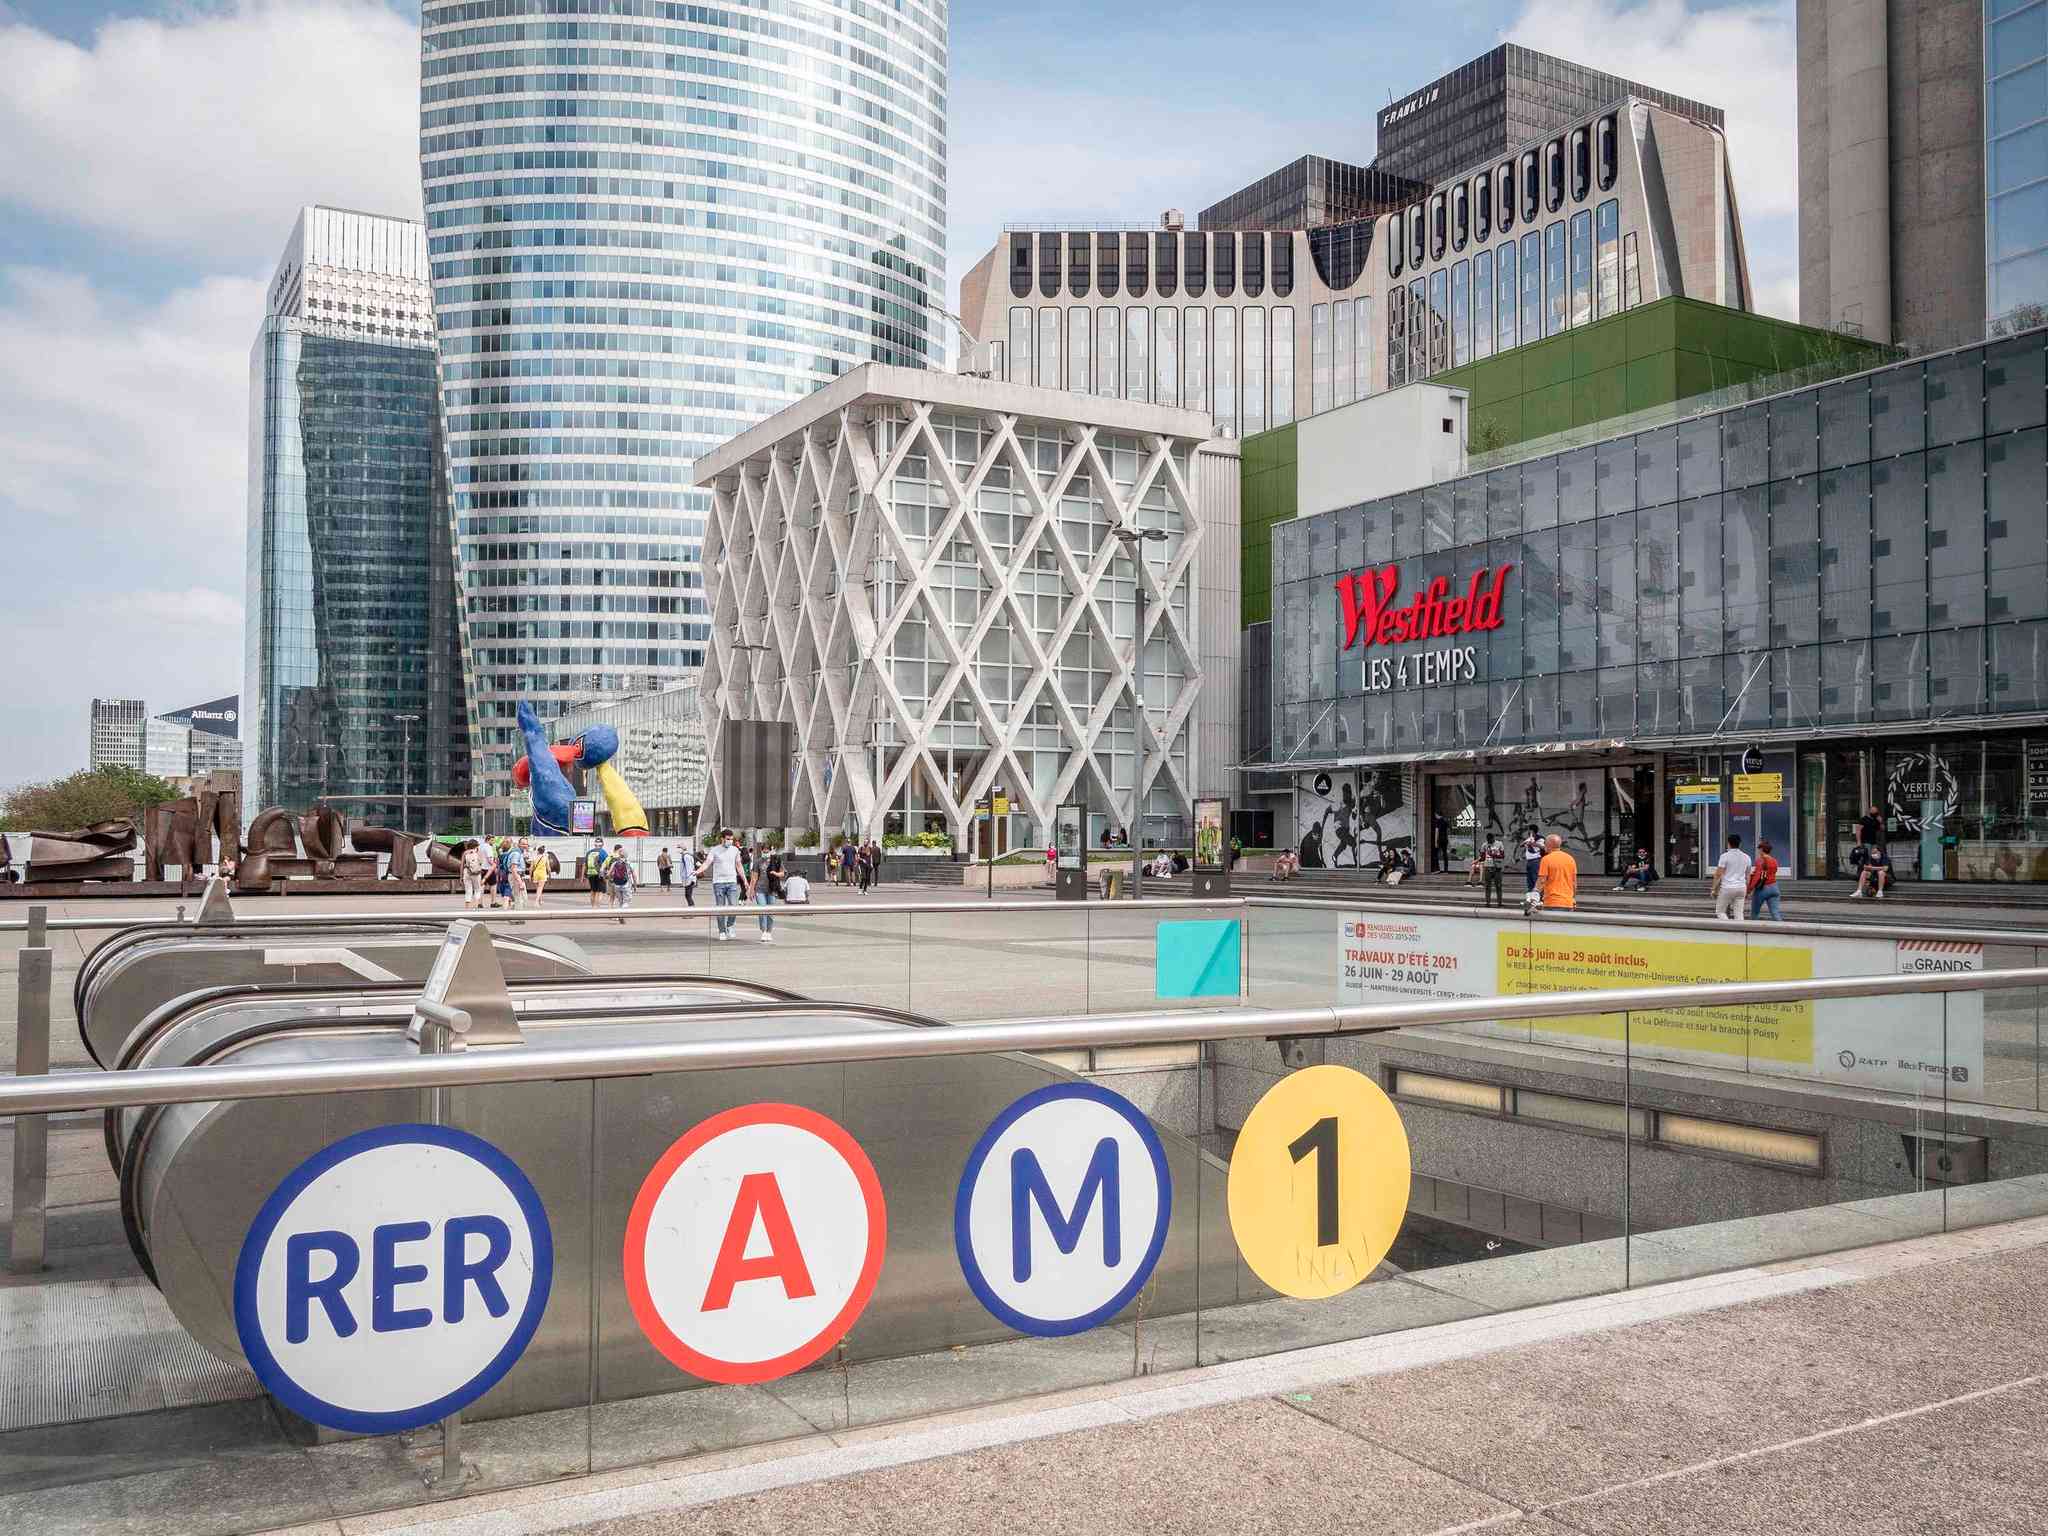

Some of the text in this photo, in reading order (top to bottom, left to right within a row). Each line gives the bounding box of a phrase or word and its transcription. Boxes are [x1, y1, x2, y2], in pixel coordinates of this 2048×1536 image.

[1384, 88, 1438, 128] FRANKLIN
[1334, 563, 1513, 651] Westfield
[1362, 646, 1476, 691] LES 4 TEMPS
[191, 711, 223, 720] Allianz
[1902, 782, 1942, 792] VERTUS
[1345, 950, 1458, 970] TRAVAUX D'ÉTÉ 2021
[1506, 947, 1520, 957] Du
[1522, 948, 1534, 958] 26
[1558, 952, 1570, 960] au
[1573, 952, 1584, 962] 29
[1588, 953, 1611, 965] août
[1614, 954, 1648, 968] inclus,
[1914, 958, 1972, 972] GRANDS
[1345, 965, 1356, 978] 26
[1358, 966, 1382, 980] JUIN
[1392, 970, 1404, 981] 29
[1406, 970, 1438, 984] AOÛT
[1567, 966, 1584, 974] entre
[1618, 970, 1688, 984] Nanterre-Université
[1795, 1004, 1804, 1013] 13
[1642, 1016, 1652, 1025] La
[1654, 1016, 1685, 1028] Défense
[1710, 1023, 1716, 1031] la
[1719, 1024, 1750, 1036] branche
[1753, 1028, 1779, 1040] Poissy
[1754, 1014, 1778, 1024] Auber
[1859, 1057, 1888, 1067] RATP
[1288, 1117, 1338, 1246] 1
[1012, 1138, 1120, 1282] M
[703, 1173, 814, 1310] A
[288, 1216, 510, 1343] RER
